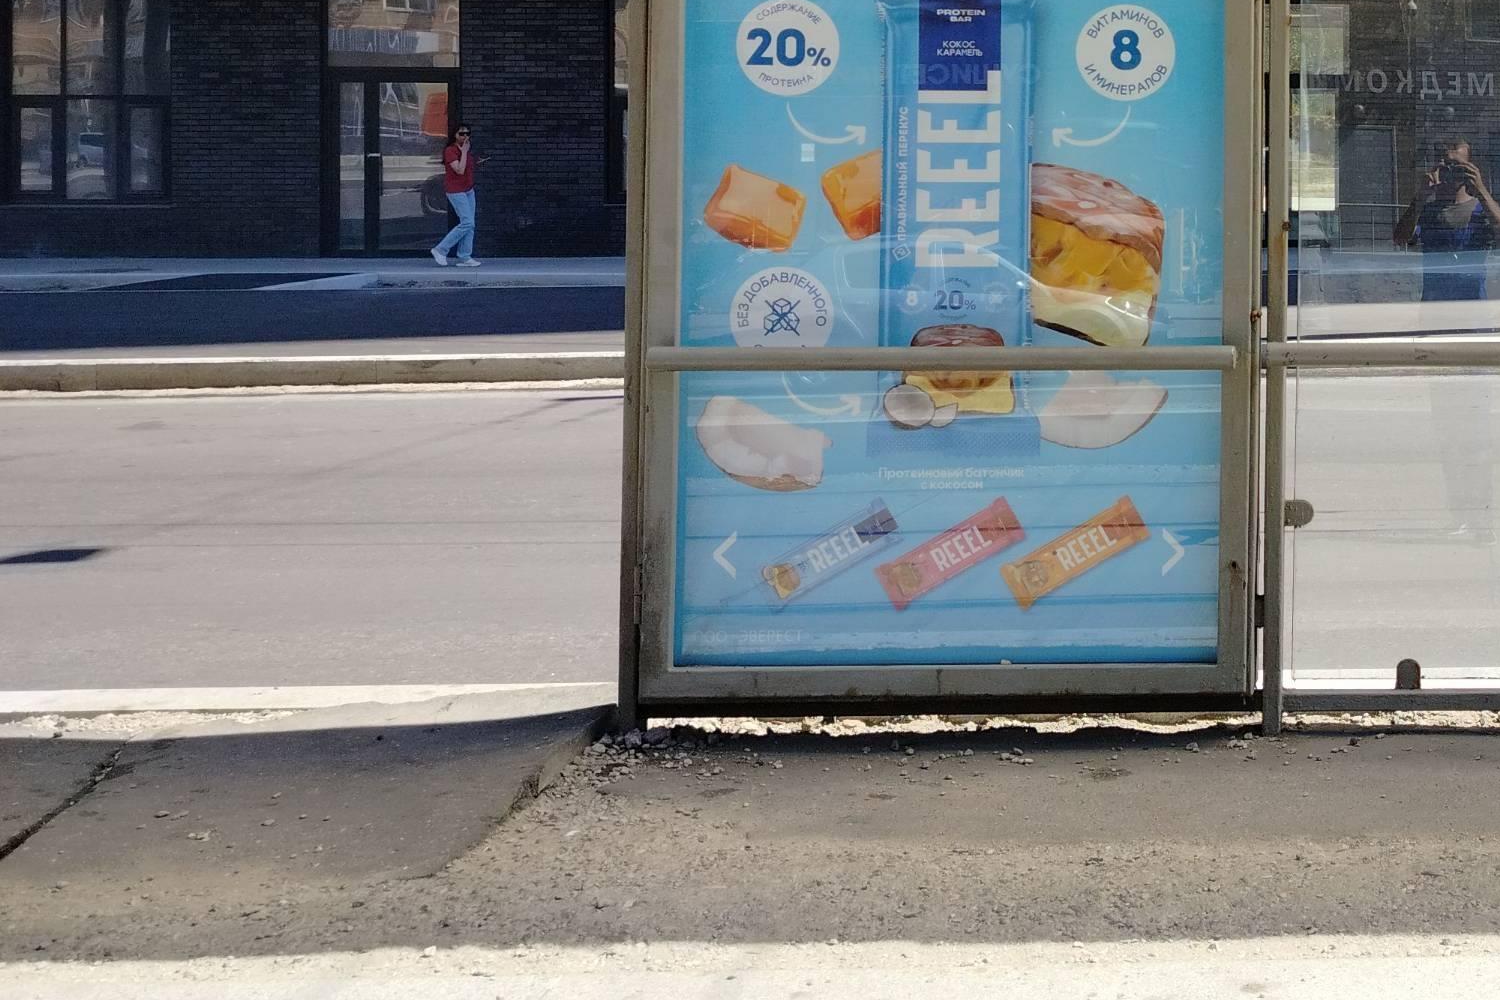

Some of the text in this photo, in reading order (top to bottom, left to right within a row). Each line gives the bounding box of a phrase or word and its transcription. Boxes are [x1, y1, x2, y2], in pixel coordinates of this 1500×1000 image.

[756, 3, 822, 24] СОДЕРЖАНИЕ
[936, 8, 986, 16] PROTEIN
[1087, 10, 1165, 39] ВИТАМИНОВ
[745, 27, 832, 67] 20%
[936, 48, 984, 57] КАРАМЕЛЬ
[942, 40, 976, 49] КОКОС
[1111, 29, 1141, 70] 8
[758, 72, 814, 87] ПРОТЕИНА
[1084, 63, 1168, 95] И МИНЕРАЛОВ
[897, 106, 909, 241] ПРАВИЛЬНЫЙ ПЕРЕКУС
[915, 70, 1001, 267] REEEL
[737, 272, 828, 328] БЕЗ ДОБАВЛЕННОГО
[933, 290, 976, 311] 20%
[878, 466, 1025, 480] Протеиновый батончик
[929, 481, 983, 490] кокосом
[806, 526, 870, 574] REEEL
[929, 525, 993, 572] REEEL
[1056, 524, 1117, 572] REEEL
